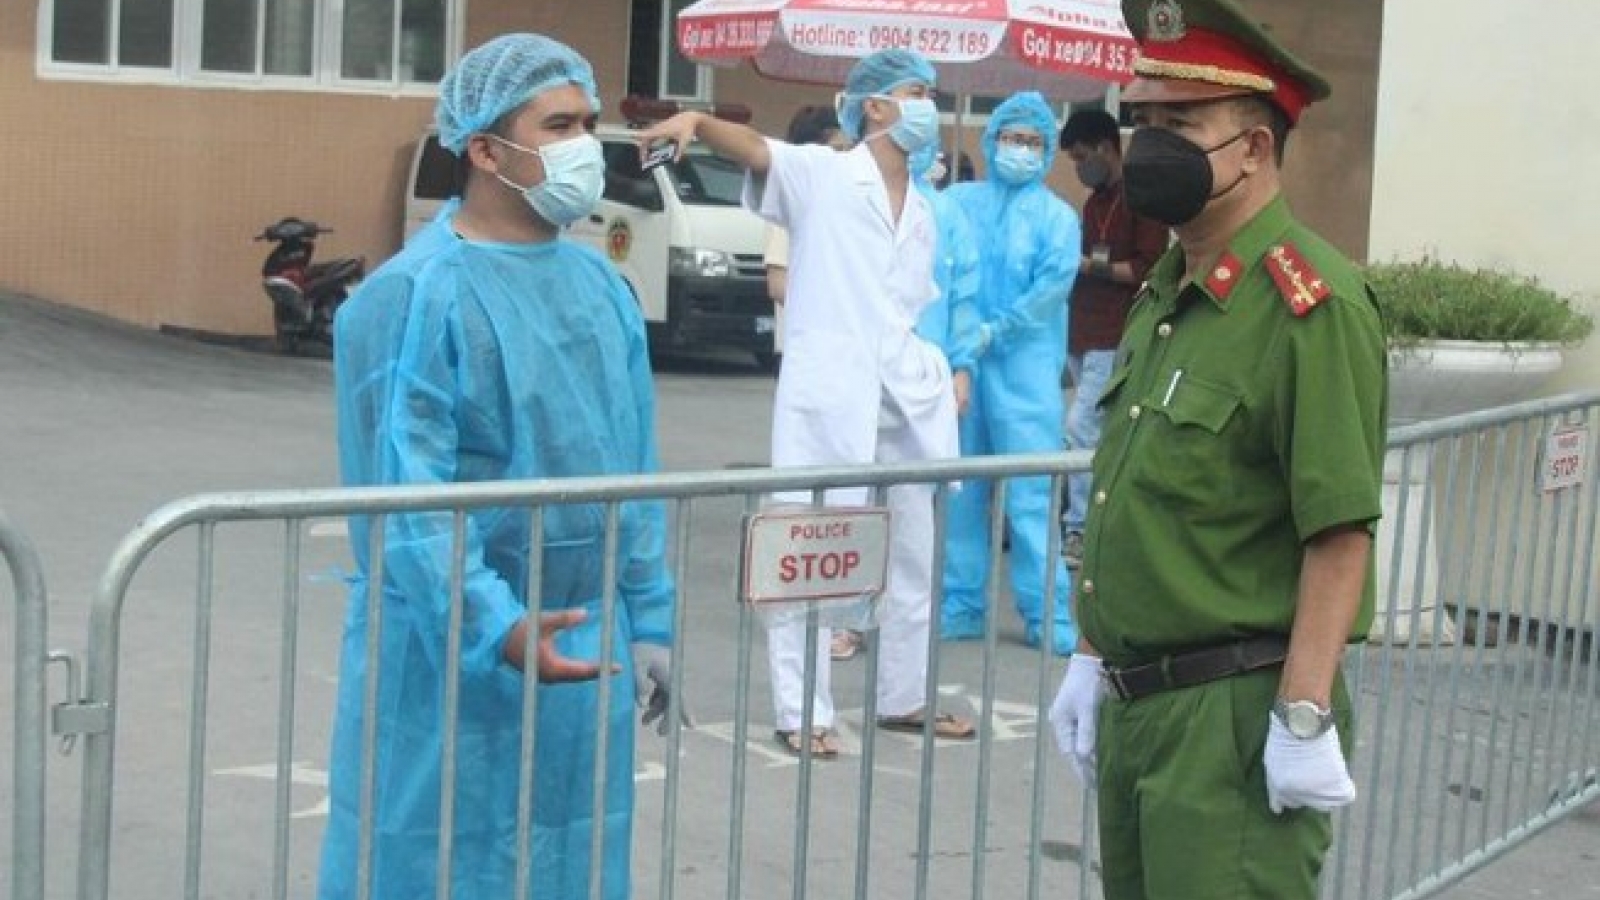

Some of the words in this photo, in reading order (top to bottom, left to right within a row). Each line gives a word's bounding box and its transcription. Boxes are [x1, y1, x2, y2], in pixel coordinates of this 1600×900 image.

[791, 23, 863, 47] Hotline:
[869, 25, 912, 49] 0904
[918, 28, 950, 54] 522
[957, 31, 989, 55] 189
[790, 521, 852, 541] POLICE
[778, 551, 861, 584] STOP
